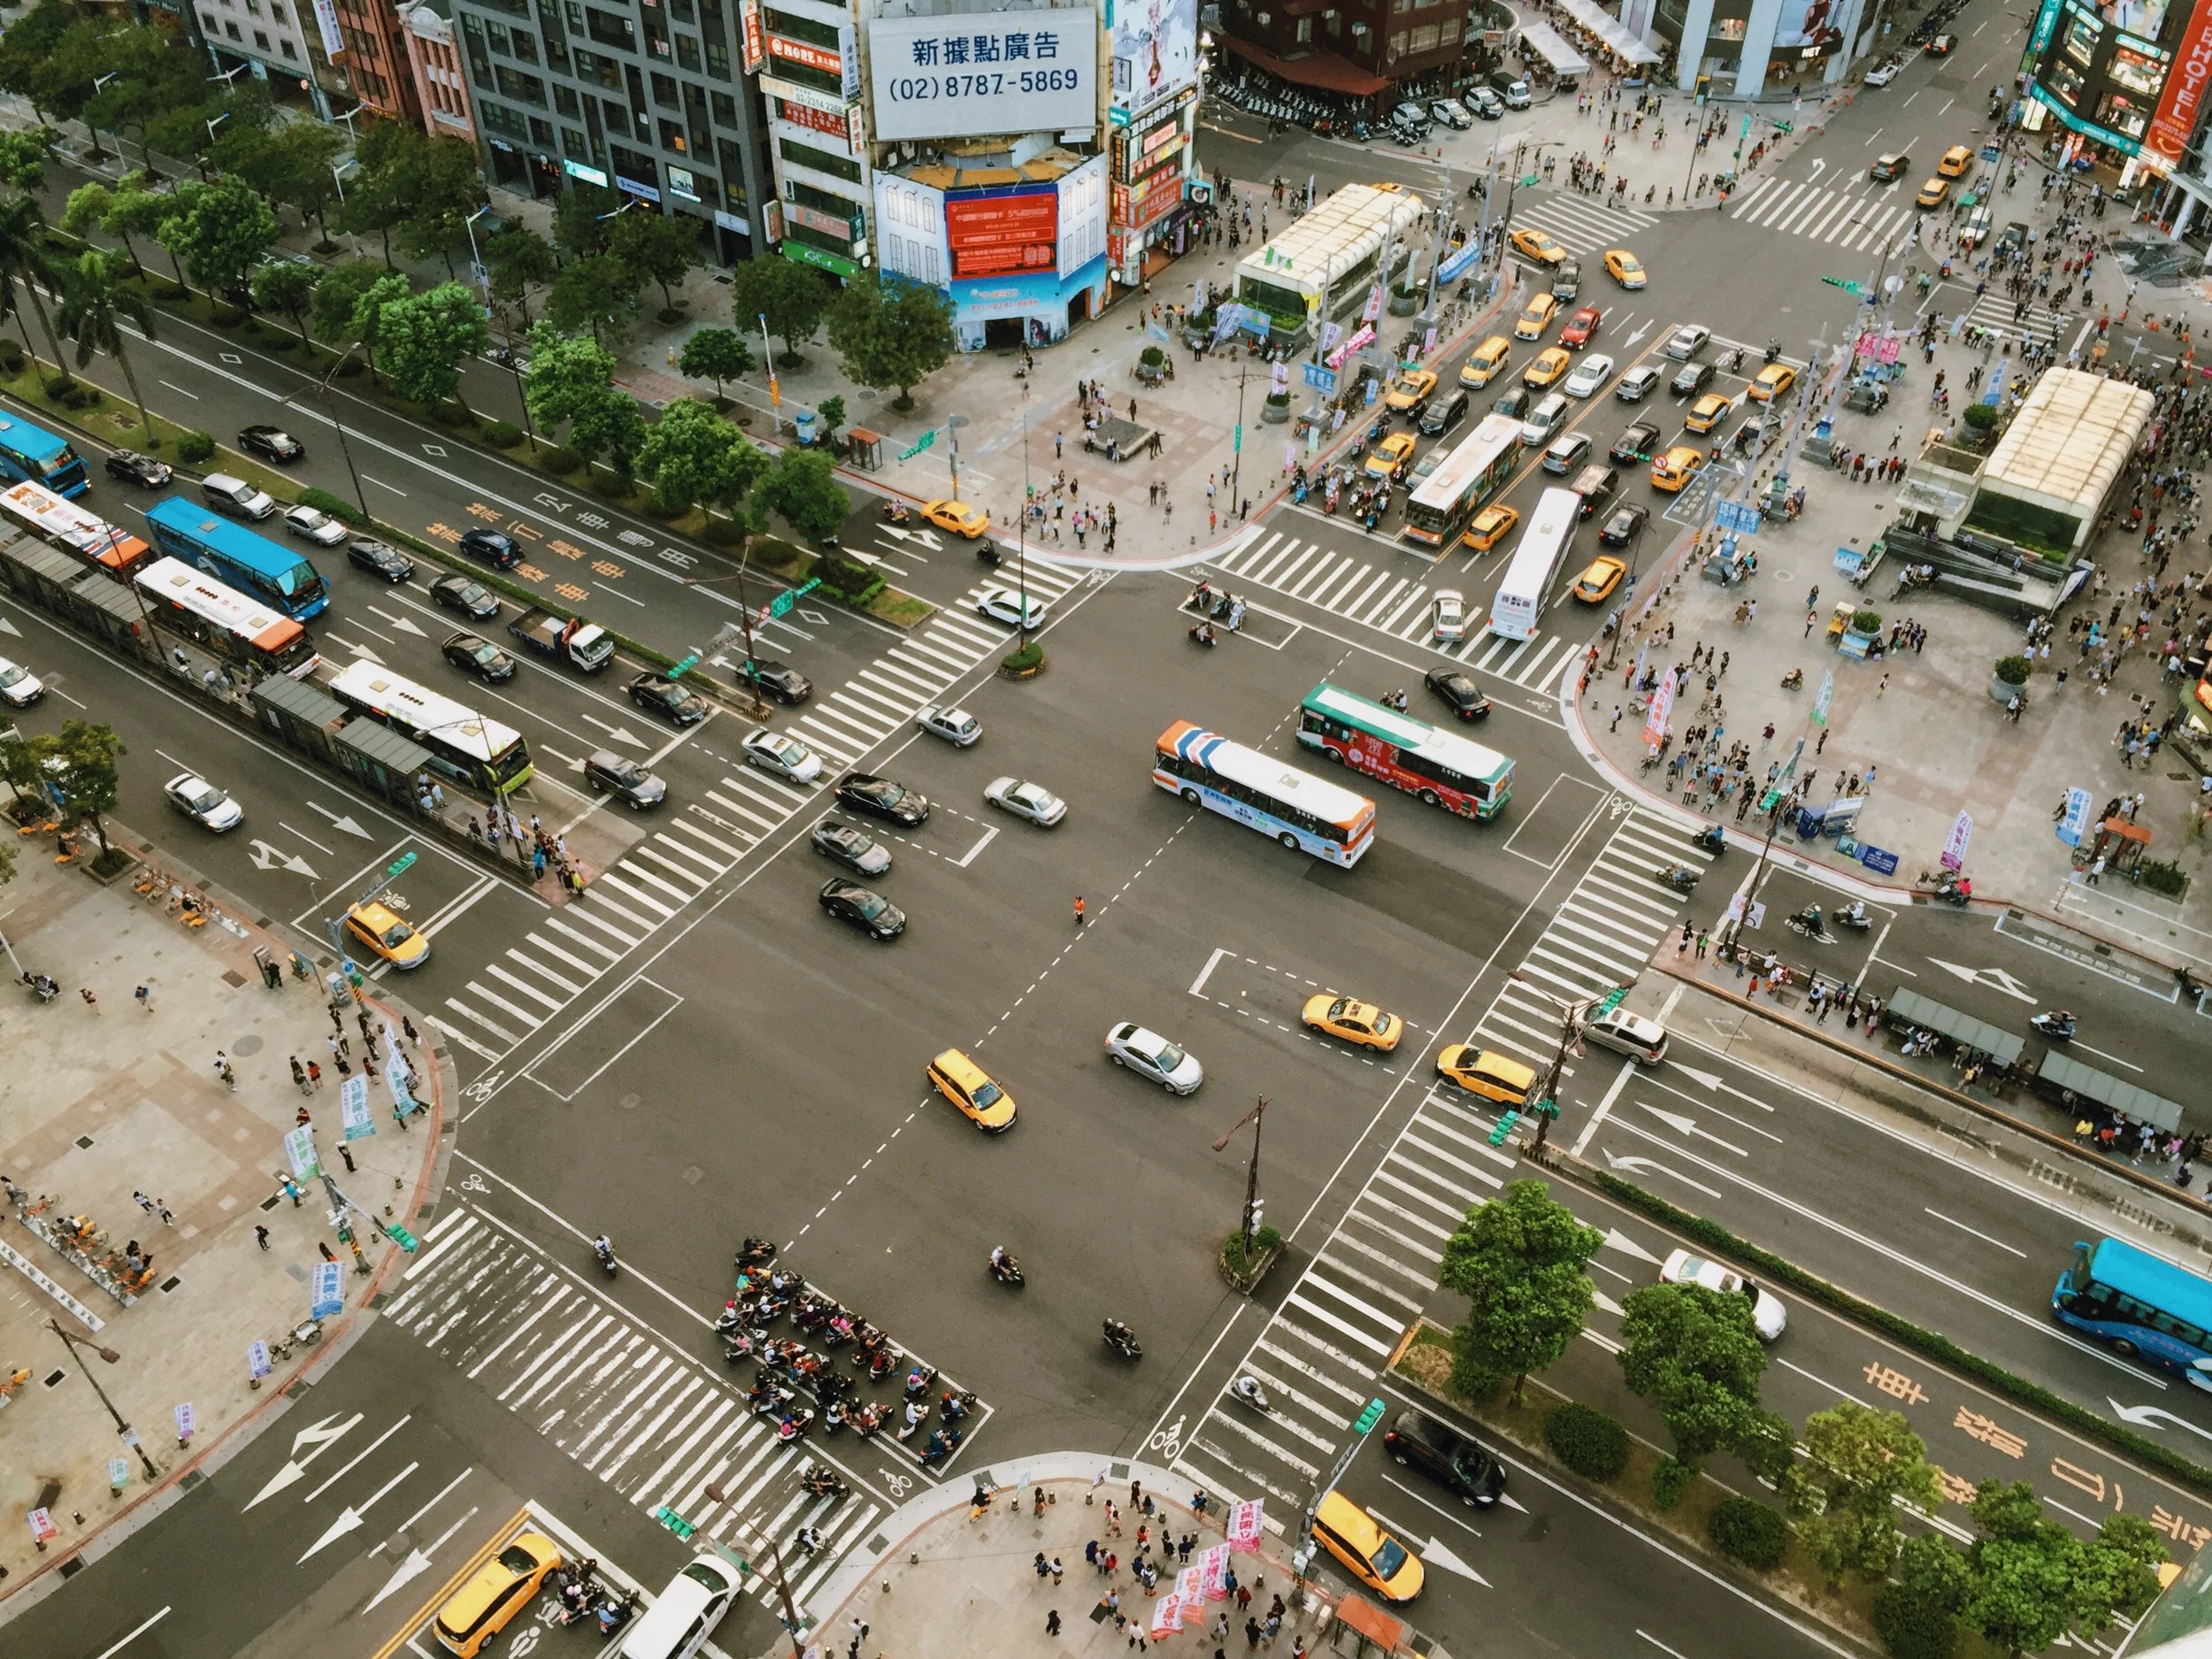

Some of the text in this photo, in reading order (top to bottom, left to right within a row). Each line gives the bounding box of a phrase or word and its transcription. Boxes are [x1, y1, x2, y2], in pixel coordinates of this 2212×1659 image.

[890, 69, 1079, 102] (02)8787-5869
[912, 32, 1060, 66] 新據點廣告
[1801, 46, 1821, 58] NET
[2172, 43, 2212, 122] HOTEL
[426, 522, 590, 603] 禁機車
[465, 502, 626, 580] 禁行機車
[534, 493, 699, 570] 公車專用
